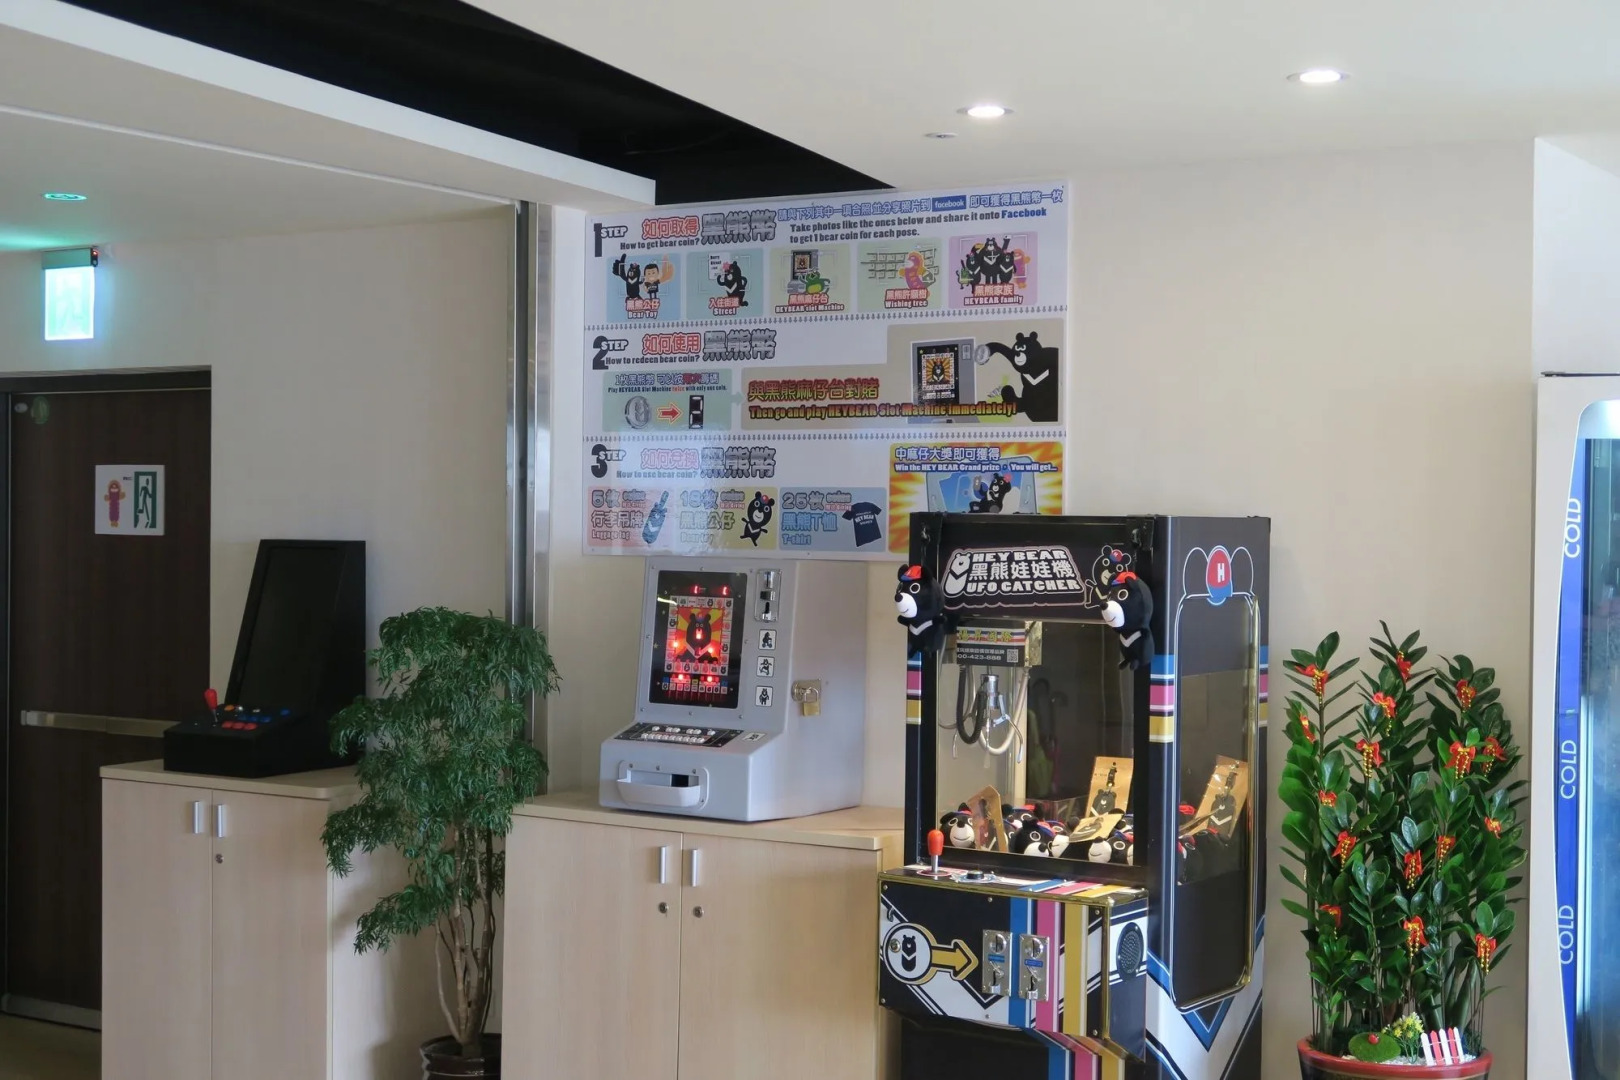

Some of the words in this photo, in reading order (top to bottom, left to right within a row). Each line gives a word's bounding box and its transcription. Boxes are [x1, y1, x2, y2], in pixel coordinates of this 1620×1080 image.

[934, 200, 964, 209] facebook
[600, 226, 628, 238] STEP
[642, 215, 700, 240] 如何取得
[701, 209, 777, 245] 黑熊幣
[790, 223, 811, 233] Take
[812, 221, 841, 233] photos
[842, 219, 858, 230] like
[859, 218, 873, 228] the
[875, 218, 896, 227] ones
[897, 216, 923, 226] below
[925, 214, 941, 223] and
[943, 212, 969, 223] share
[971, 212, 978, 221] it
[979, 211, 1000, 220] onto
[1001, 207, 1047, 219] Facebook
[620, 242, 637, 250] How
[638, 241, 646, 249] to
[647, 241, 659, 250] get
[659, 239, 677, 248] bear
[678, 238, 700, 247] coin?
[790, 235, 799, 243] to
[800, 234, 813, 244] get
[814, 234, 819, 242] 1
[819, 232, 839, 242] bear
[840, 231, 859, 240] coin
[859, 230, 872, 239] for
[873, 229, 895, 238] each
[896, 228, 920, 239] pose.
[884, 300, 912, 309] Wishing
[912, 299, 928, 307] tree
[964, 297, 999, 306] HEYBEAR
[1000, 295, 1023, 305] family
[713, 307, 737, 316] Street
[593, 336, 609, 370] 2
[601, 339, 629, 351] STEP
[642, 332, 701, 355] 如何使用
[702, 328, 777, 361] 黑熊幣
[605, 356, 623, 364] How
[659, 355, 677, 363] bear
[677, 354, 700, 363] coin?
[749, 405, 774, 419] Then
[774, 407, 787, 420] go
[787, 405, 805, 418] and
[805, 405, 828, 420] play
[828, 403, 877, 418] HEYBEAR
[879, 403, 901, 416] Slot
[901, 403, 947, 416] Machine
[948, 401, 1017, 417] immediately!
[591, 444, 608, 478] 3
[598, 449, 626, 461] STEP
[895, 446, 1001, 461] 中麻仔大獎即可獲得
[701, 446, 776, 478] 黑熊幣
[895, 463, 908, 472] Win
[909, 463, 920, 471] the
[921, 463, 938, 471] HEY
[938, 463, 959, 471] BEAR
[959, 463, 981, 471] Grand
[982, 463, 1000, 473] prize
[1010, 463, 1029, 471] You
[1029, 463, 1039, 471] will
[657, 470, 674, 478] bear
[676, 470, 697, 478] coin?
[591, 509, 645, 528] 行李吊牌
[1564, 498, 1581, 558] COLD
[972, 551, 1010, 563] HEY
[1013, 549, 1068, 561] BEAR
[968, 560, 1075, 581] 黑熊娃娃機
[1217, 562, 1225, 583] H
[966, 581, 998, 593] UFO
[1000, 579, 1081, 592] CATCHER
[1560, 740, 1577, 800] COLD
[1558, 905, 1574, 965] COLD
